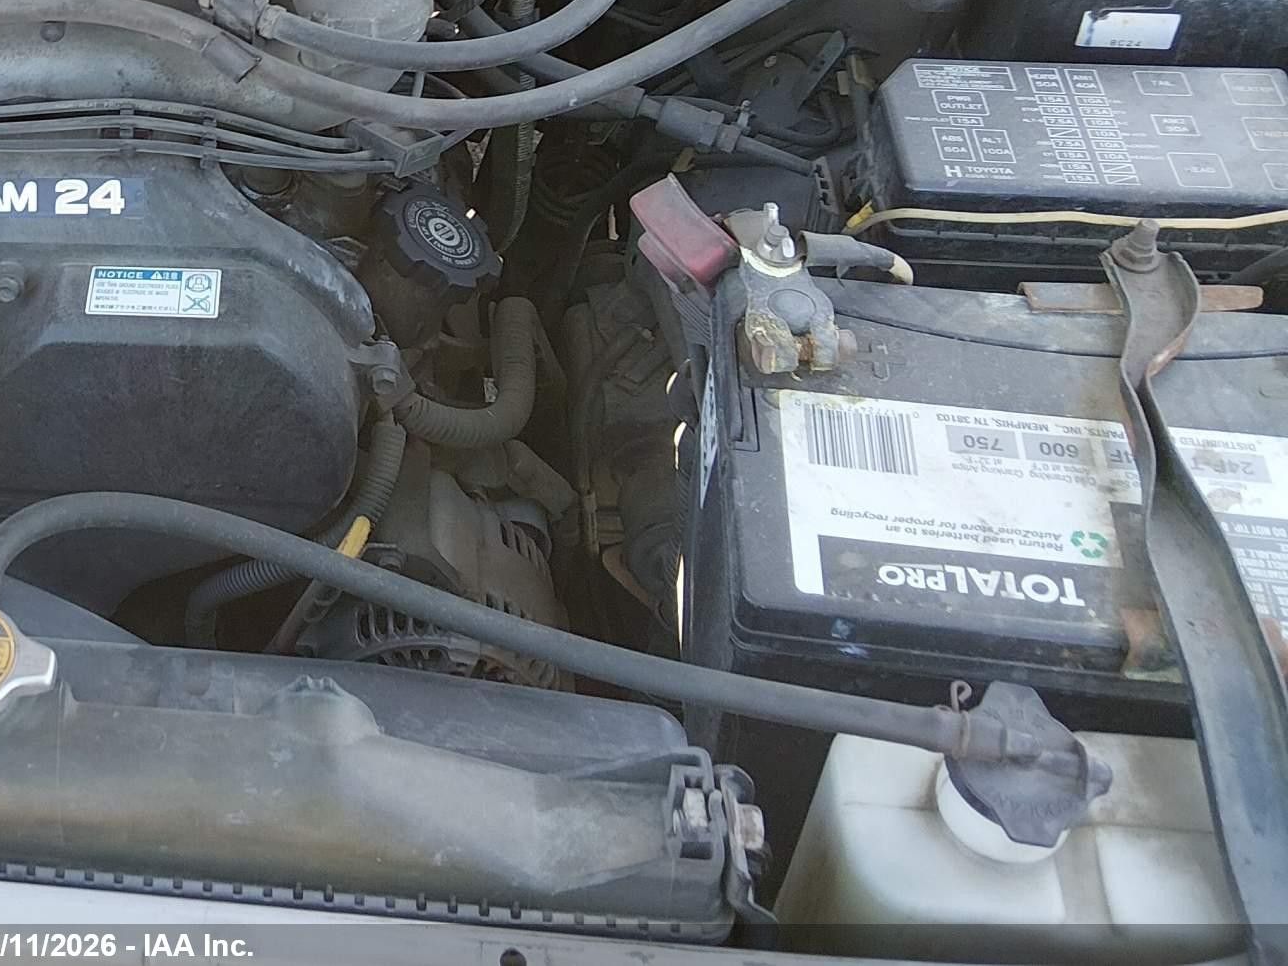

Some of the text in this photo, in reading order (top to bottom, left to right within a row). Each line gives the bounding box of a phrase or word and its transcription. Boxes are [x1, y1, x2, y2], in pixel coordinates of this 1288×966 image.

[940, 102, 983, 110] OUTLET
[944, 165, 963, 178] H
[967, 166, 1015, 175] TOYOTA
[54, 179, 126, 215] 24
[97, 270, 144, 279] NOTICE
[974, 417, 990, 426] TN
[963, 434, 1005, 452] 750
[1039, 442, 1079, 458] 600
[830, 507, 887, 523] recycling
[891, 513, 934, 527] proper
[937, 520, 957, 530] for
[959, 521, 992, 534] store
[885, 524, 1063, 552] Return used batteries to an
[878, 564, 1085, 607] TOTALPRO
